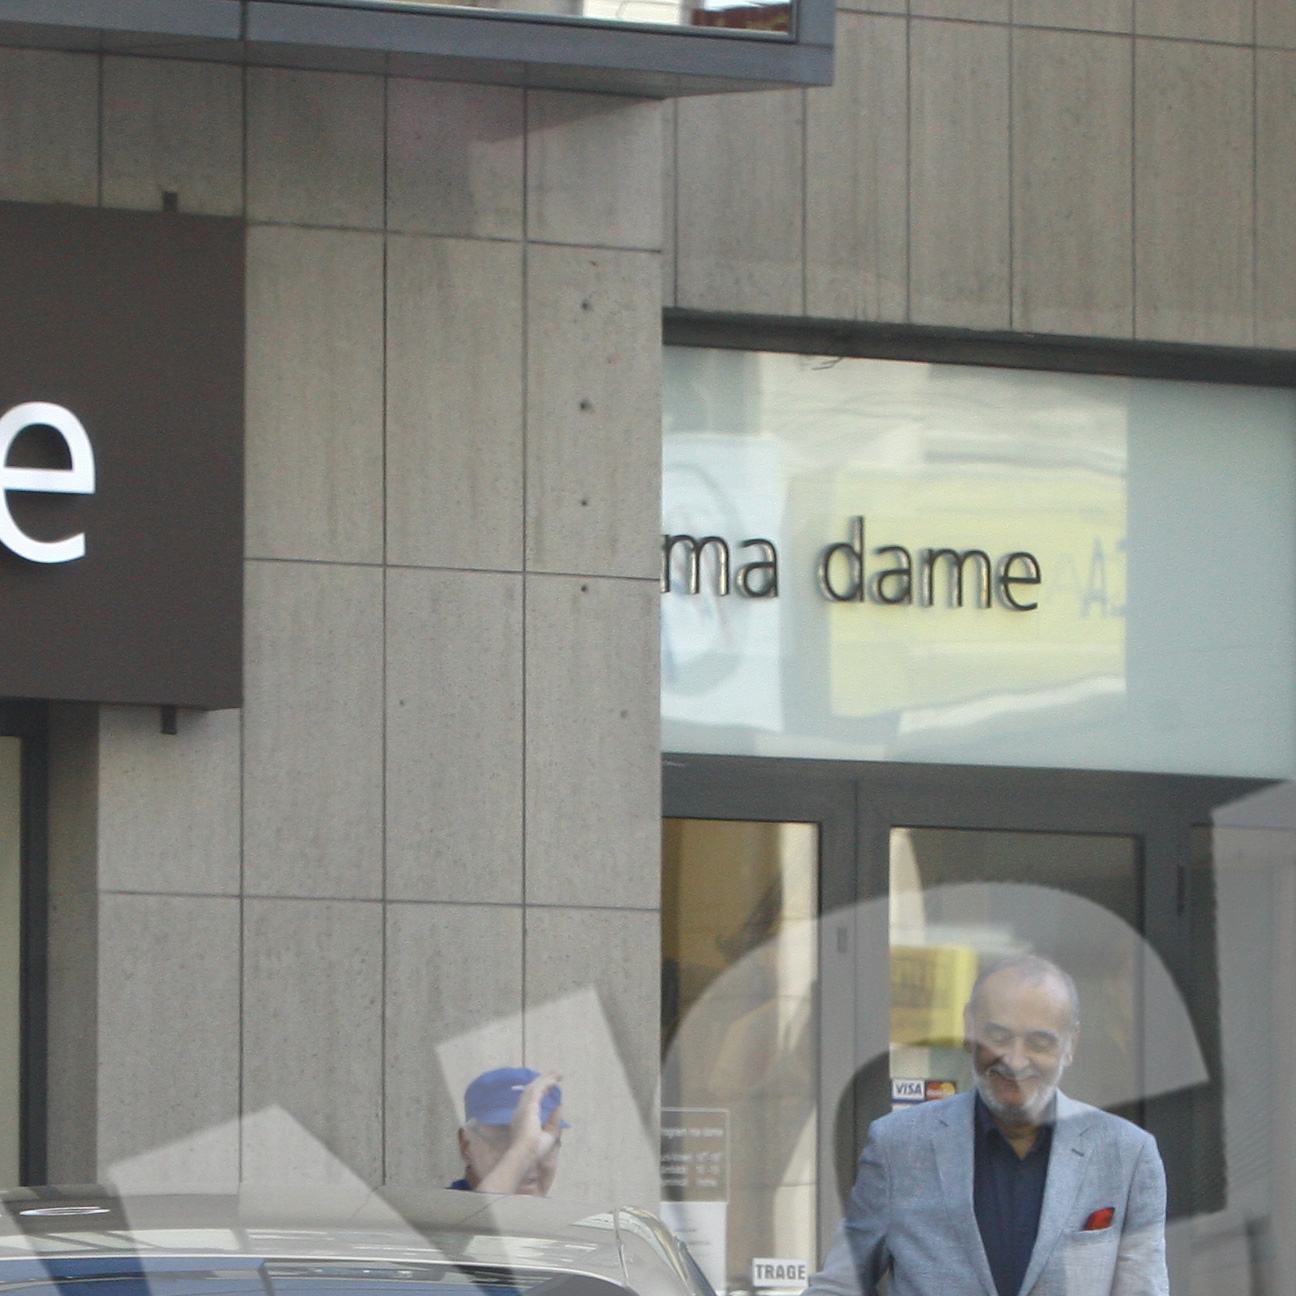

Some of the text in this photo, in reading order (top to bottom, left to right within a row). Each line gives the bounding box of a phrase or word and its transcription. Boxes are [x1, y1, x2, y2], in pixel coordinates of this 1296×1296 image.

[661, 531, 778, 599] ma
[816, 516, 1042, 611] dame
[895, 1082, 923, 1095] VISA
[755, 1264, 806, 1280] TRAGE
